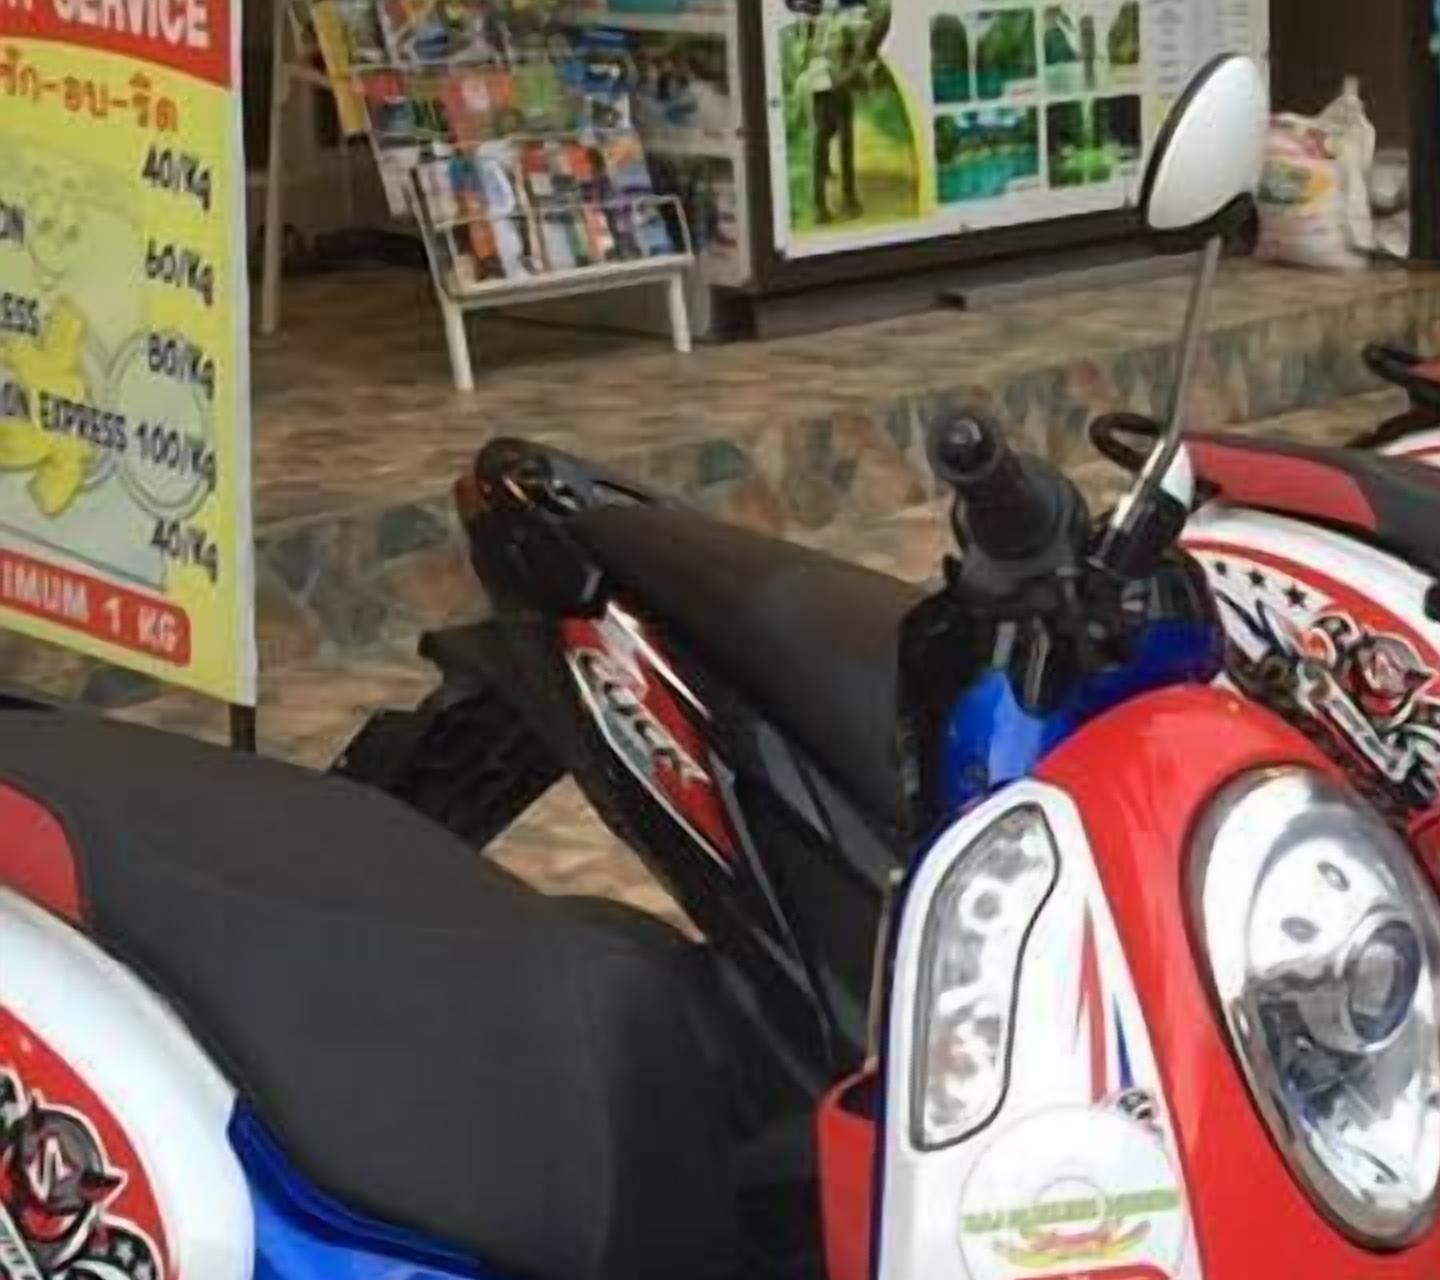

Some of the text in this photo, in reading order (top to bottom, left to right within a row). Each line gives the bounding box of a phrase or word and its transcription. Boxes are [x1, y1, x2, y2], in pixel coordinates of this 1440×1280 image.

[39, 391, 127, 452] EXPRESS
[103, 594, 123, 637] 1
[137, 603, 178, 654] KG
